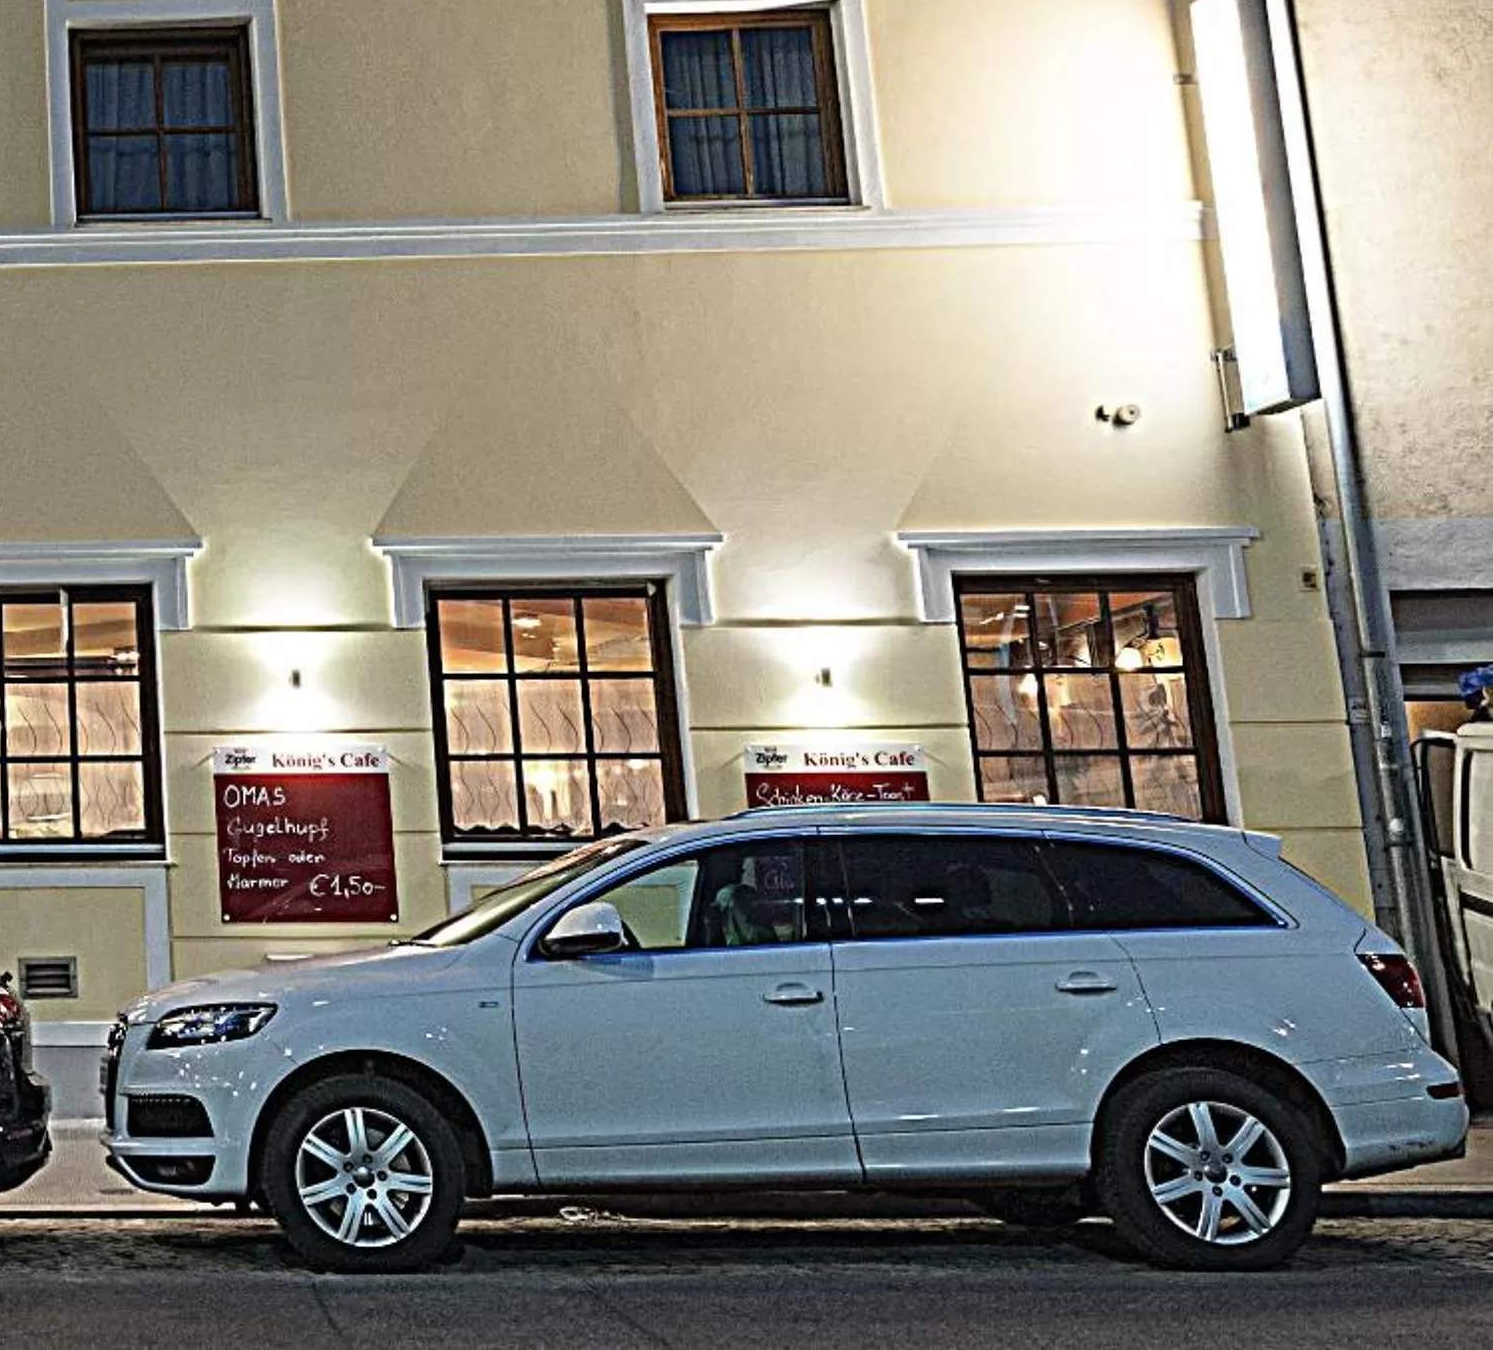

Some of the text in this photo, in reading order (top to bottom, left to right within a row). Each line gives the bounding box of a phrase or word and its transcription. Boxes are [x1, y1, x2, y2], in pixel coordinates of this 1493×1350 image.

[225, 754, 256, 767] Zipfer
[272, 753, 335, 769] König's
[803, 752, 869, 769] König's
[223, 784, 286, 808] OMAS
[227, 816, 329, 843] Gugelhupf
[288, 850, 325, 864] oder
[227, 873, 289, 890] Marmor
